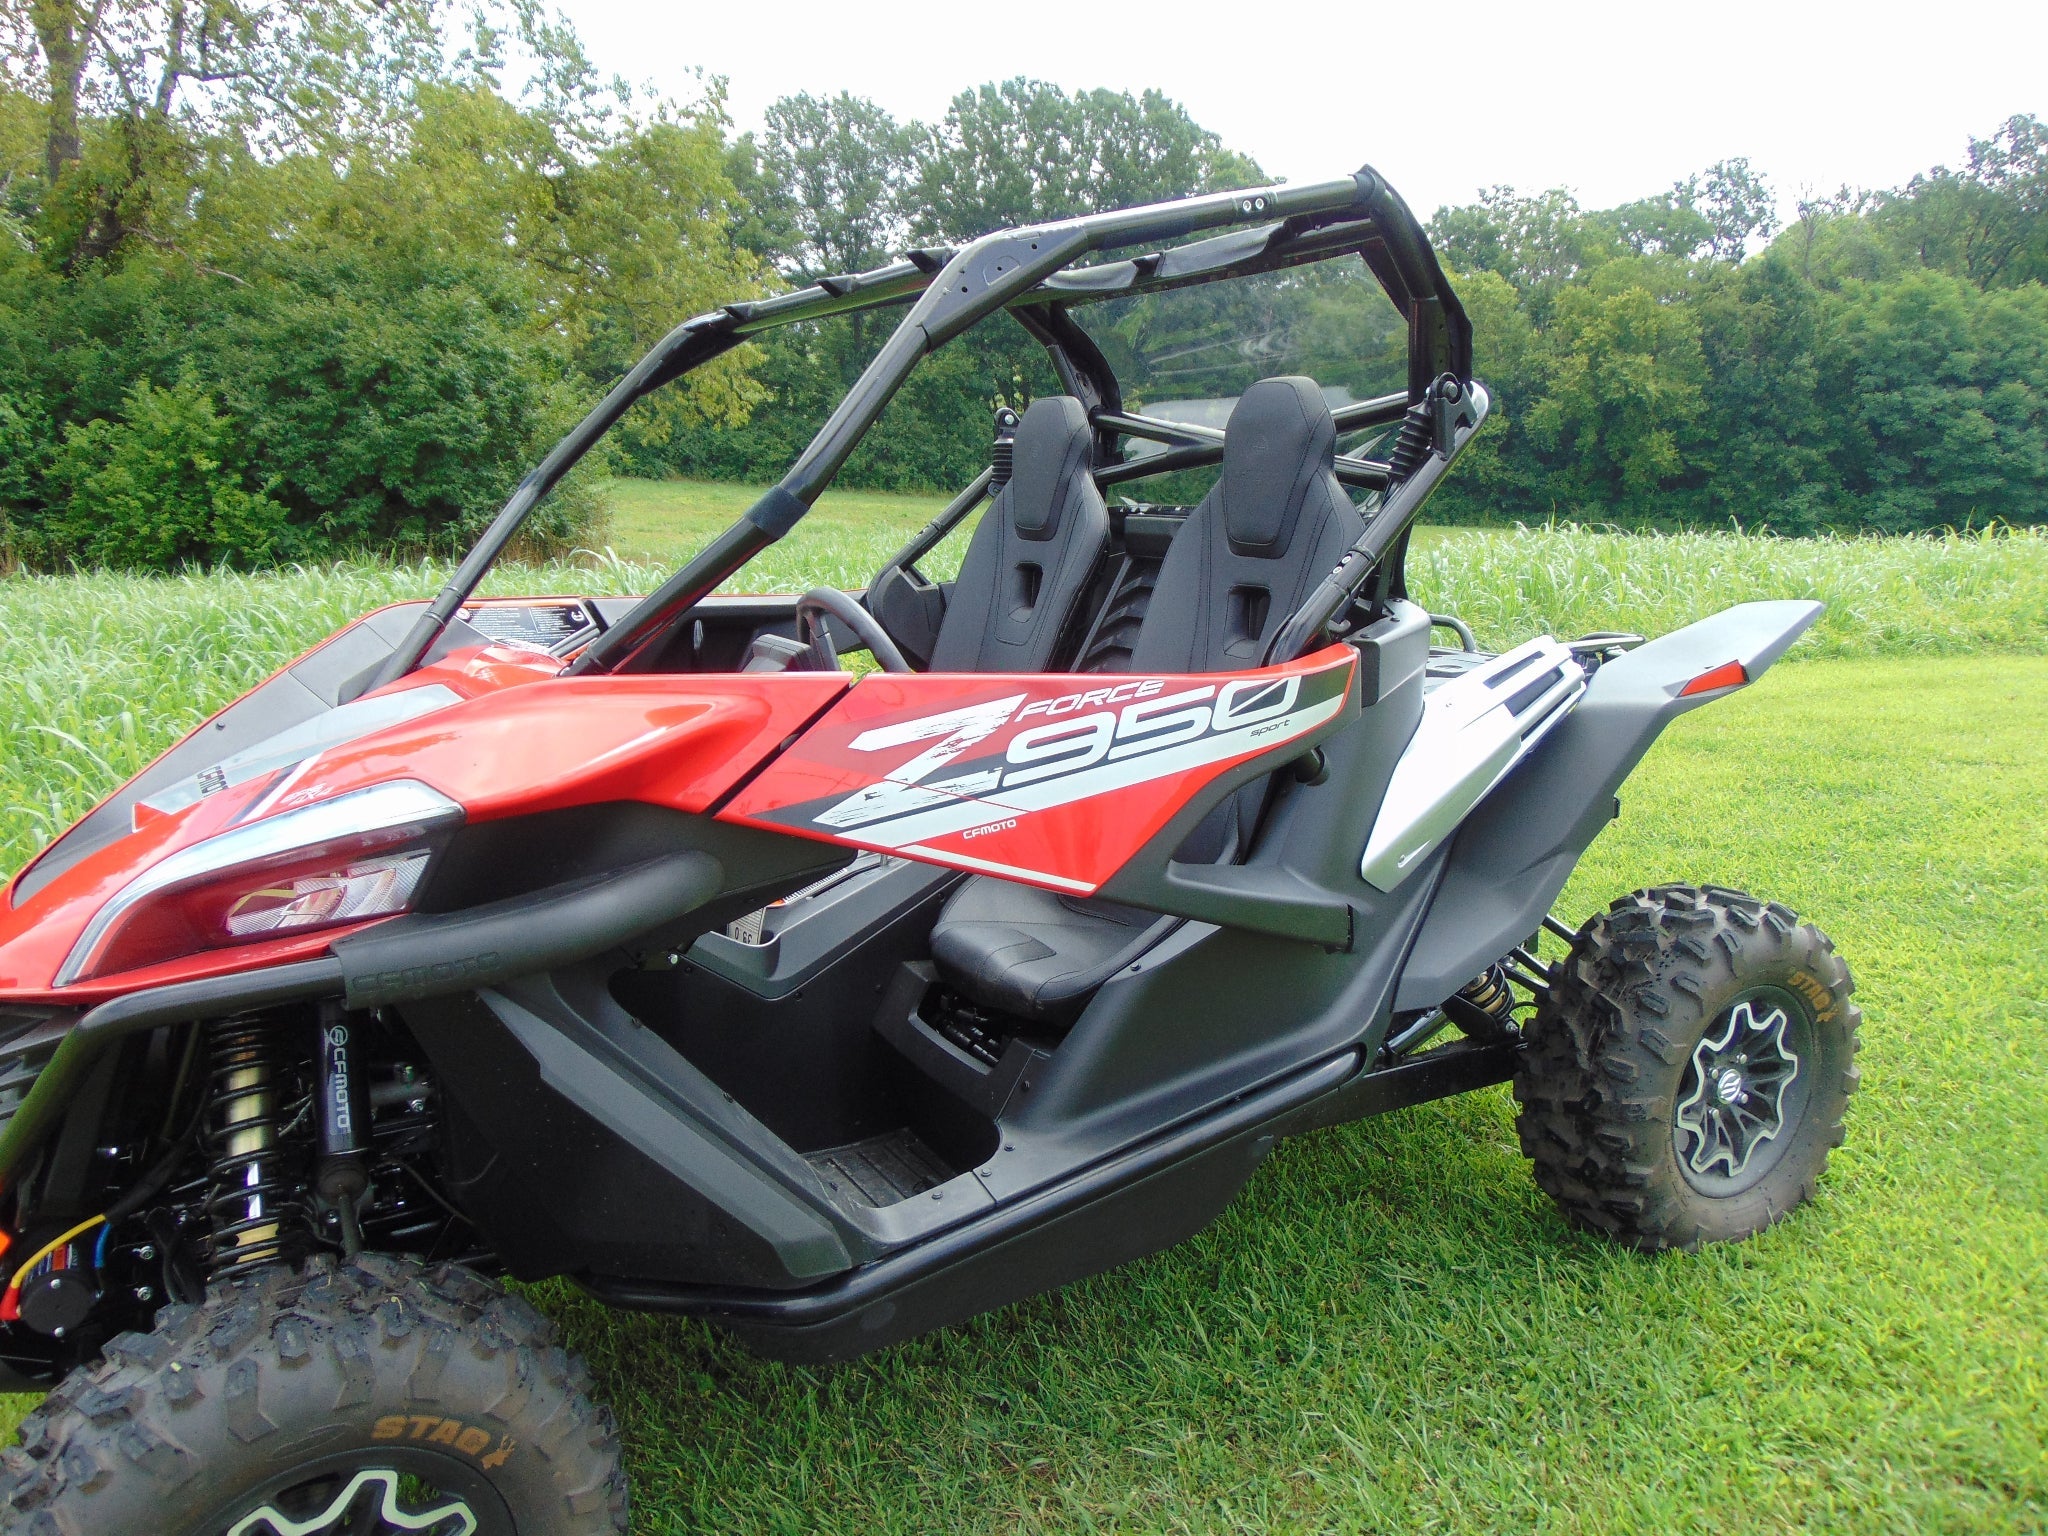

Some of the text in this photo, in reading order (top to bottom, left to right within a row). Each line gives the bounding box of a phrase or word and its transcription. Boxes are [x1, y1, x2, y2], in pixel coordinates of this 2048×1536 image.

[1014, 680, 1166, 722] FORCE
[1003, 675, 1302, 787] 950
[1250, 719, 1291, 737] sport
[962, 818, 1017, 840] CFMOTO
[333, 1047, 351, 1129] CFMOTO
[370, 1414, 492, 1456] STAG
